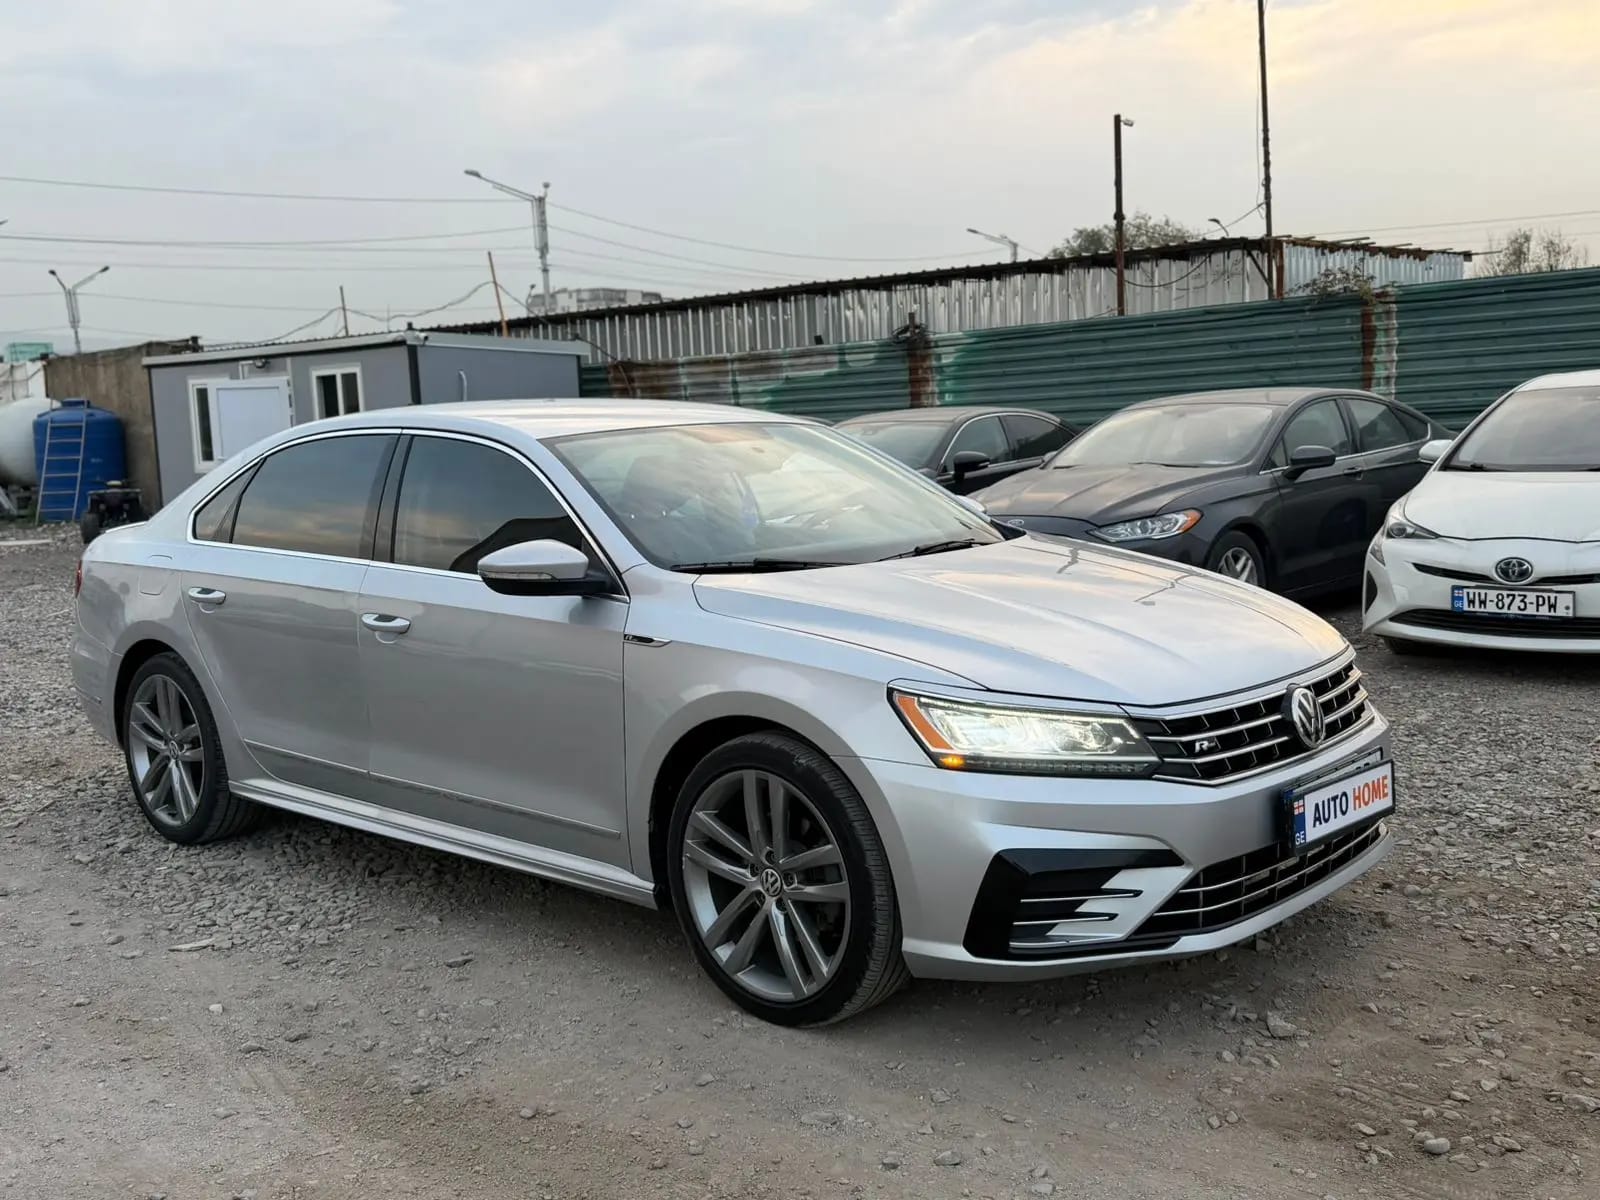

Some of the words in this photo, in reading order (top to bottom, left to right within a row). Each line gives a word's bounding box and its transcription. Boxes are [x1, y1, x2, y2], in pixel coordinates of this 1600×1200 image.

[1454, 600, 1464, 608] GE
[1466, 591, 1558, 613] WW-873-PW
[1312, 791, 1349, 828] AUTO
[1353, 774, 1389, 811] HOME
[1295, 830, 1306, 846] GE
